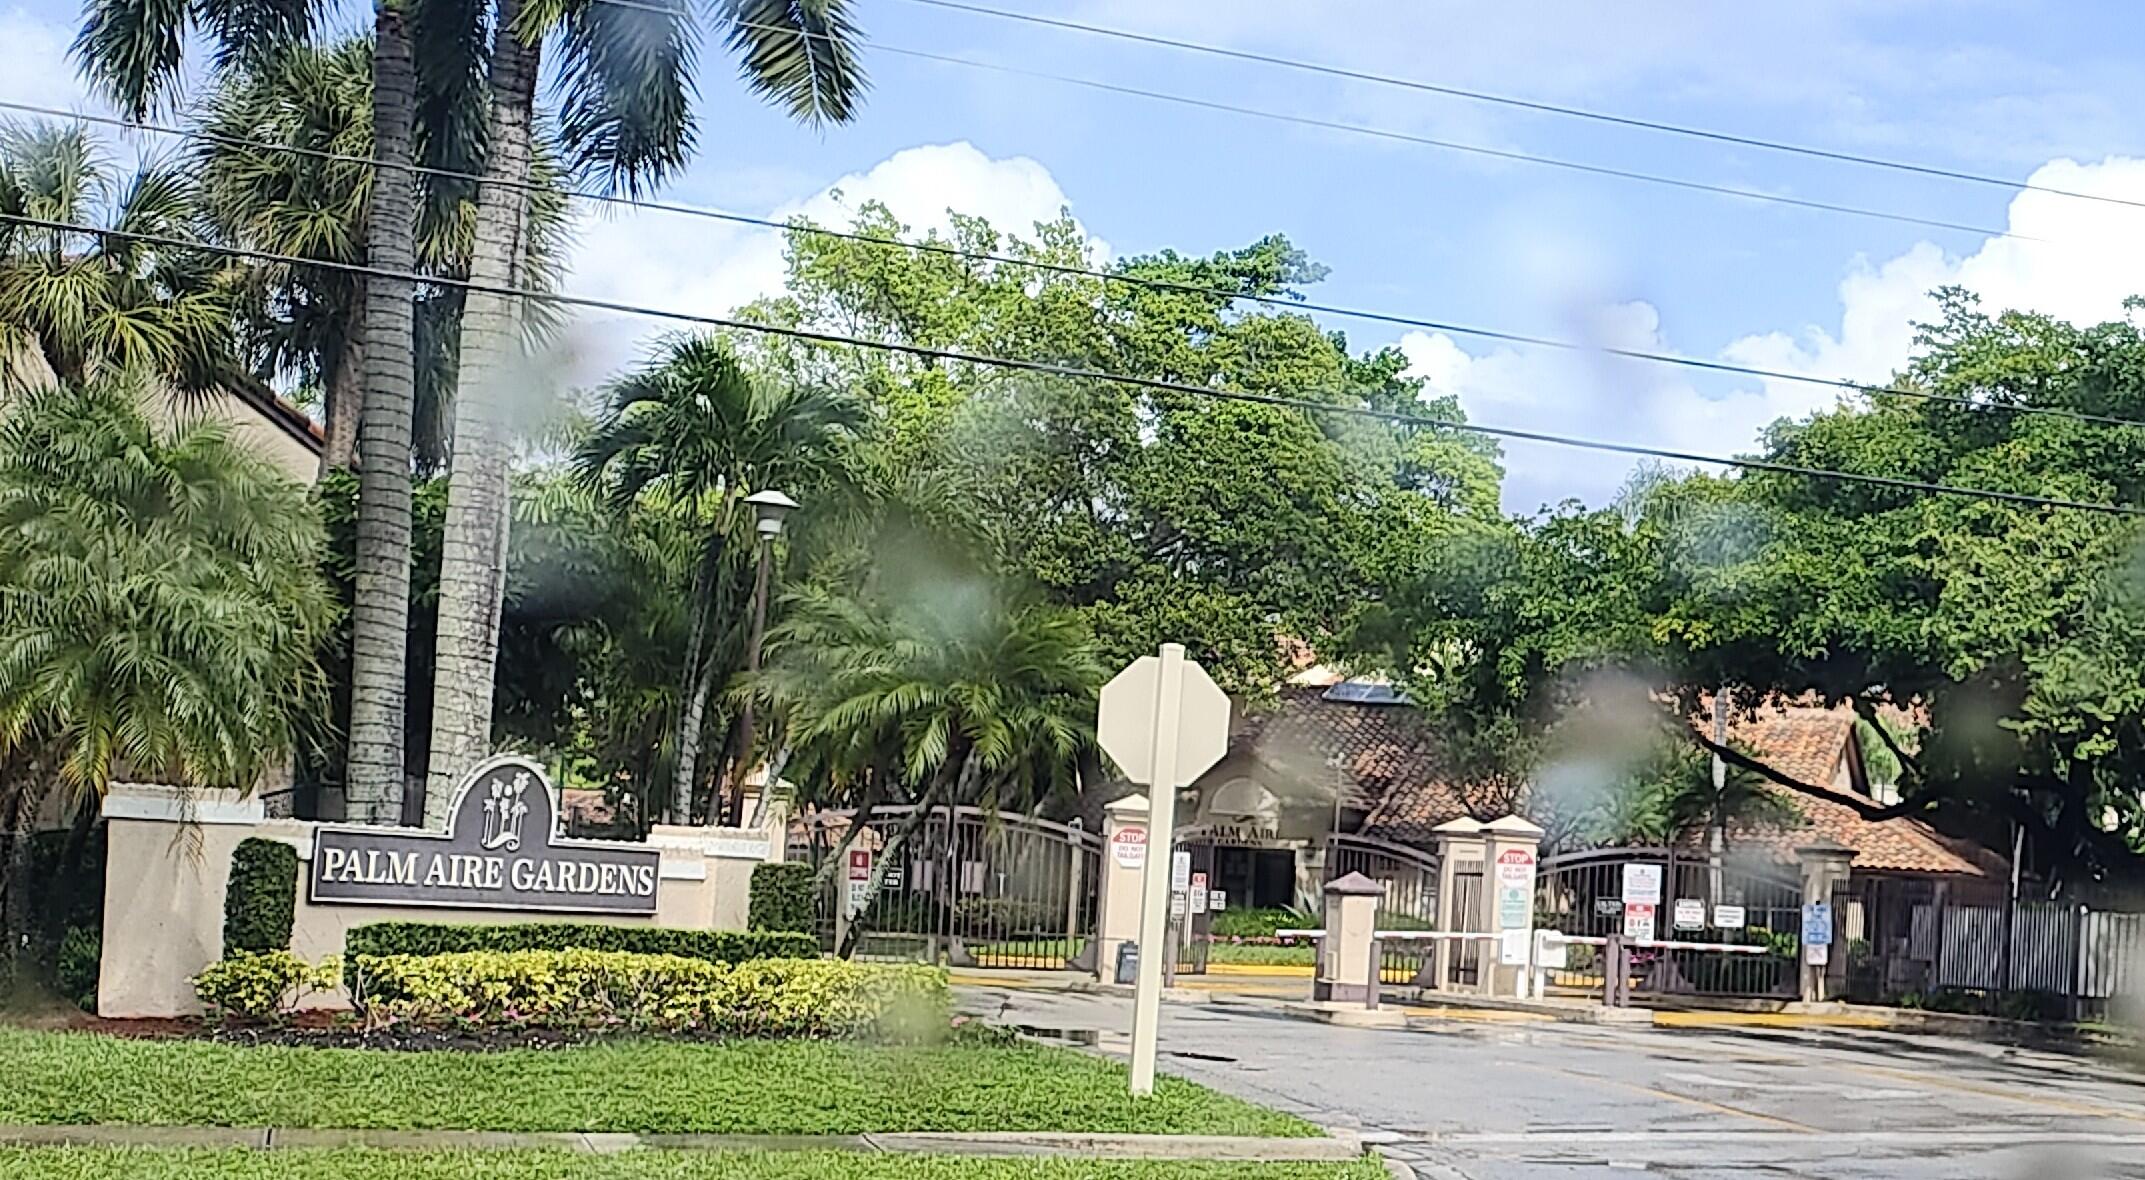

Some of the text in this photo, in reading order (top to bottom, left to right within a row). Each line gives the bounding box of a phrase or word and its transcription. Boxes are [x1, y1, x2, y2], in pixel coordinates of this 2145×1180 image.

[1119, 832, 1147, 843] STOP
[1503, 853, 1529, 864] STOP
[321, 848, 656, 897] PALM AIRE GARDENS
